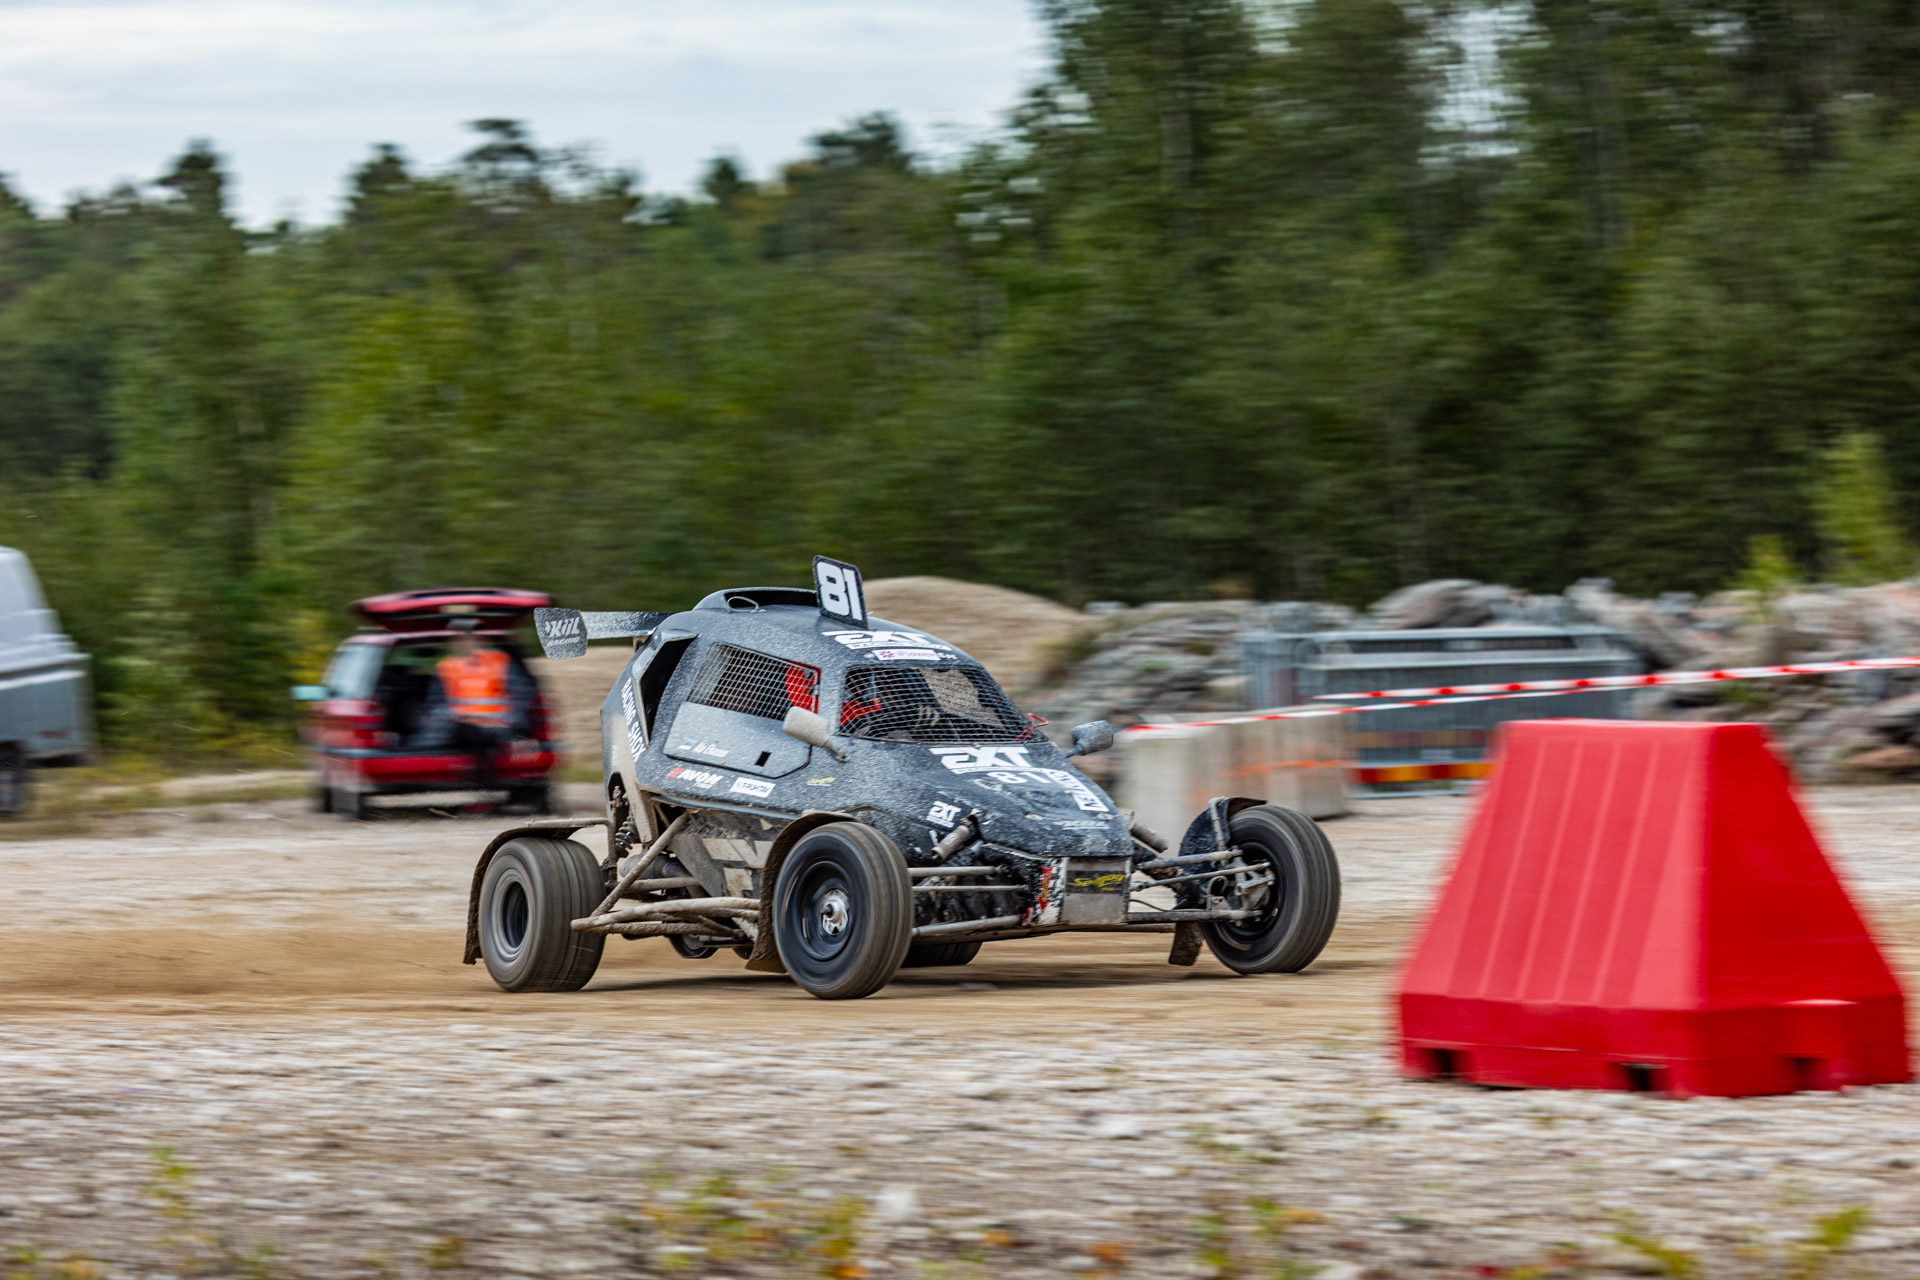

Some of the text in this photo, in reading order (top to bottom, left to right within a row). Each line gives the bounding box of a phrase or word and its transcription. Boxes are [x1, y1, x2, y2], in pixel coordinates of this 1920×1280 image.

[817, 561, 864, 622] 81
[547, 637, 580, 646] RACING
[621, 677, 646, 762] RACING SHOX
[676, 769, 724, 785] AVON
[986, 771, 1051, 784] 81
